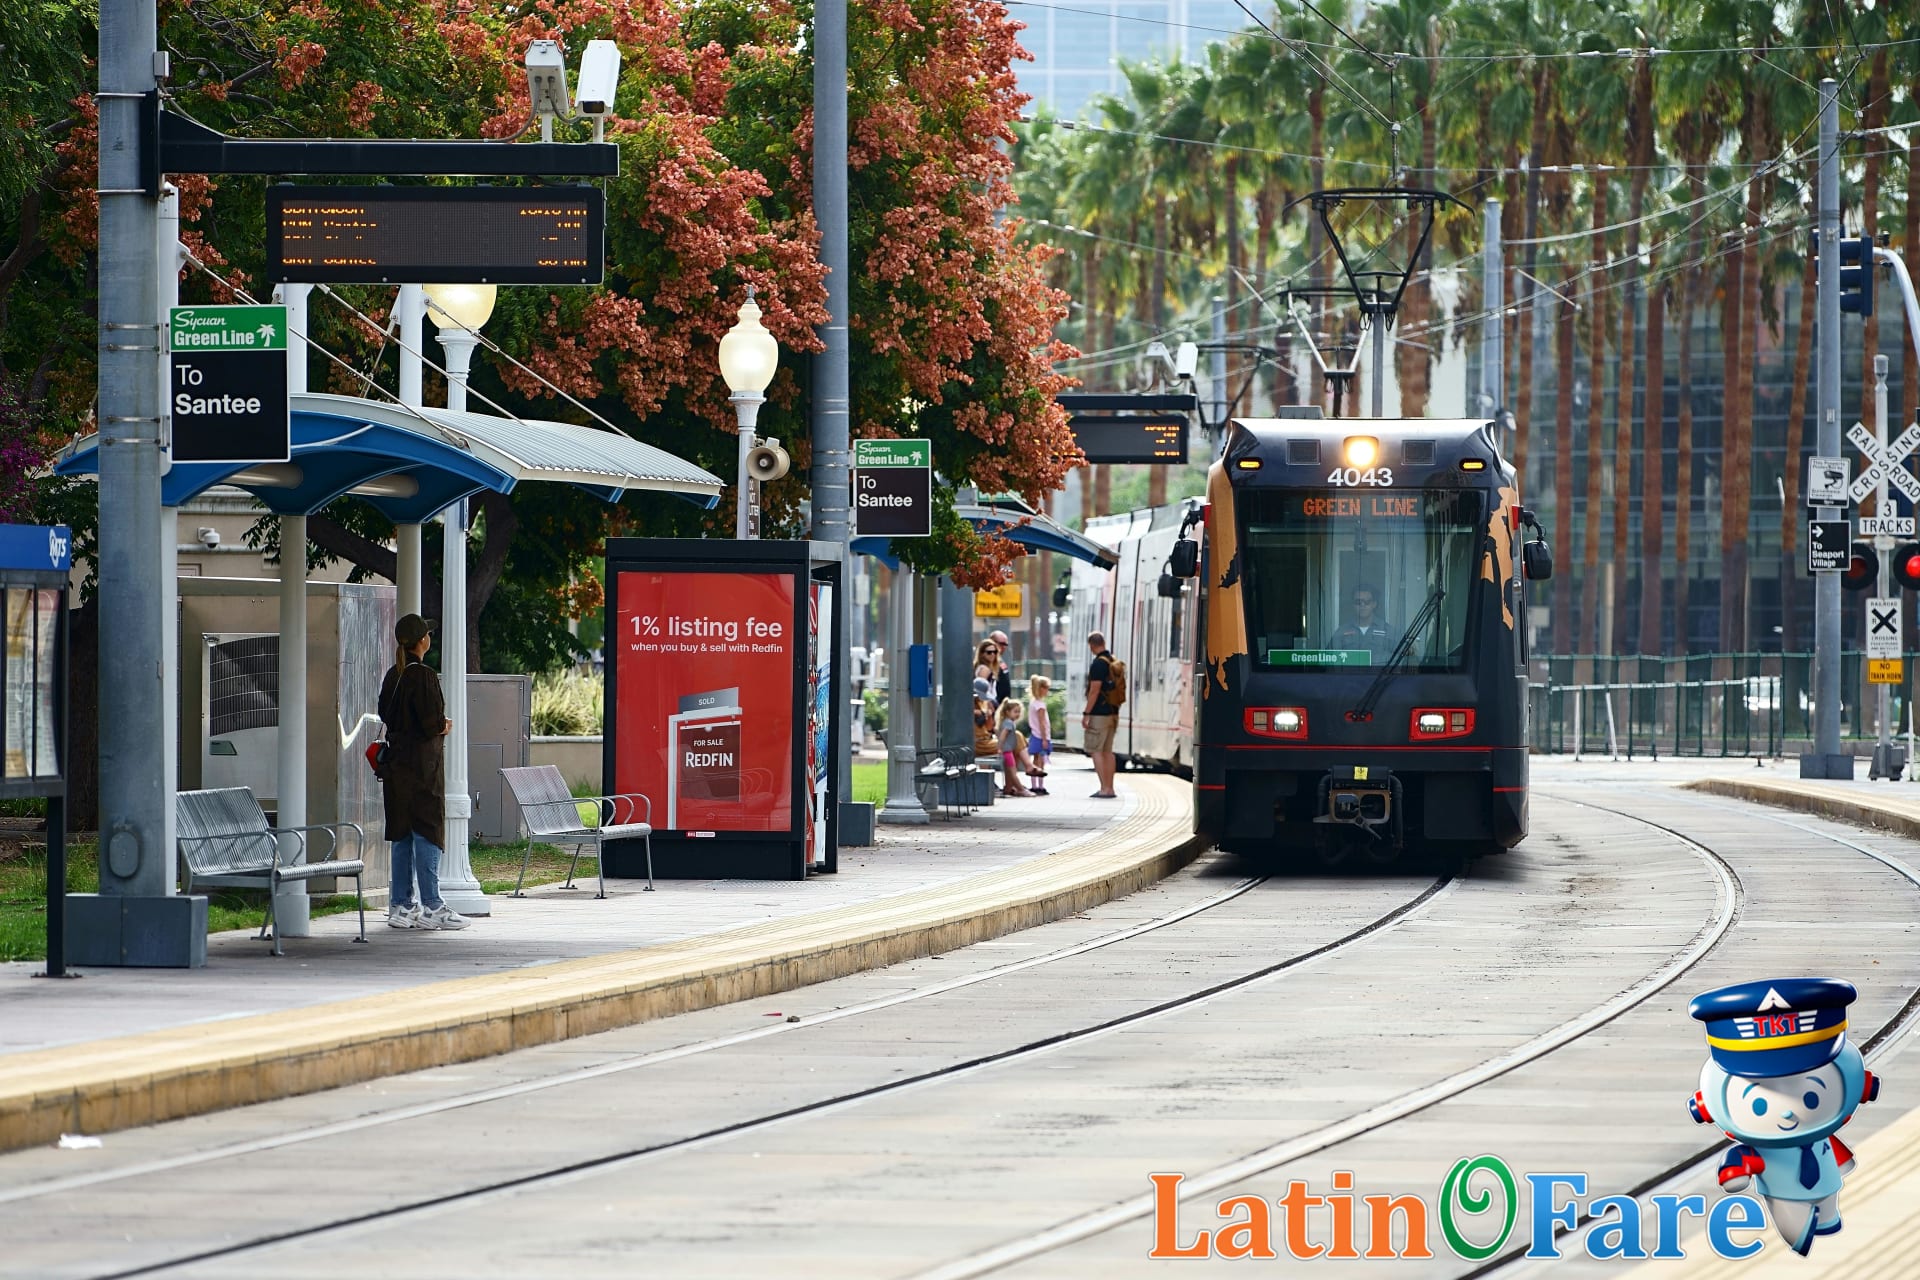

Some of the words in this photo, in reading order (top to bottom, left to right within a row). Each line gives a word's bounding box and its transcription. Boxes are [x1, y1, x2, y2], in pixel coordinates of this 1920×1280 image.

[175, 311, 227, 330] Sycuan
[174, 330, 220, 346] Green
[222, 329, 255, 345] Line
[175, 364, 203, 385] To
[175, 393, 261, 415] Santee
[858, 442, 892, 455] Sycuan
[858, 454, 887, 465] Green
[888, 454, 909, 465] Line
[858, 475, 877, 489] To
[1327, 467, 1394, 487] 4043
[858, 493, 913, 507] Santee
[1303, 498, 1361, 517] GREEN
[1371, 498, 1418, 517] LINE
[1883, 501, 1892, 518] 3
[1862, 519, 1913, 533] TRACKS
[50, 537, 67, 558] MTS
[1812, 541, 1823, 550] To
[1812, 550, 1845, 560] Seaport
[1812, 559, 1837, 569] Village
[630, 615, 660, 636] 1%
[668, 616, 739, 642] listing
[745, 617, 783, 638] fee
[631, 643, 658, 652] when
[660, 644, 678, 654] you
[680, 643, 699, 654] buy
[700, 643, 707, 652] &
[709, 643, 726, 652] sell
[728, 643, 750, 653] with
[751, 643, 783, 654] Redfin
[1291, 653, 1318, 662] Green
[1319, 653, 1338, 662] Line
[698, 697, 715, 706] SOLD
[706, 738, 724, 747] SALE
[685, 752, 733, 768] REDFIN
